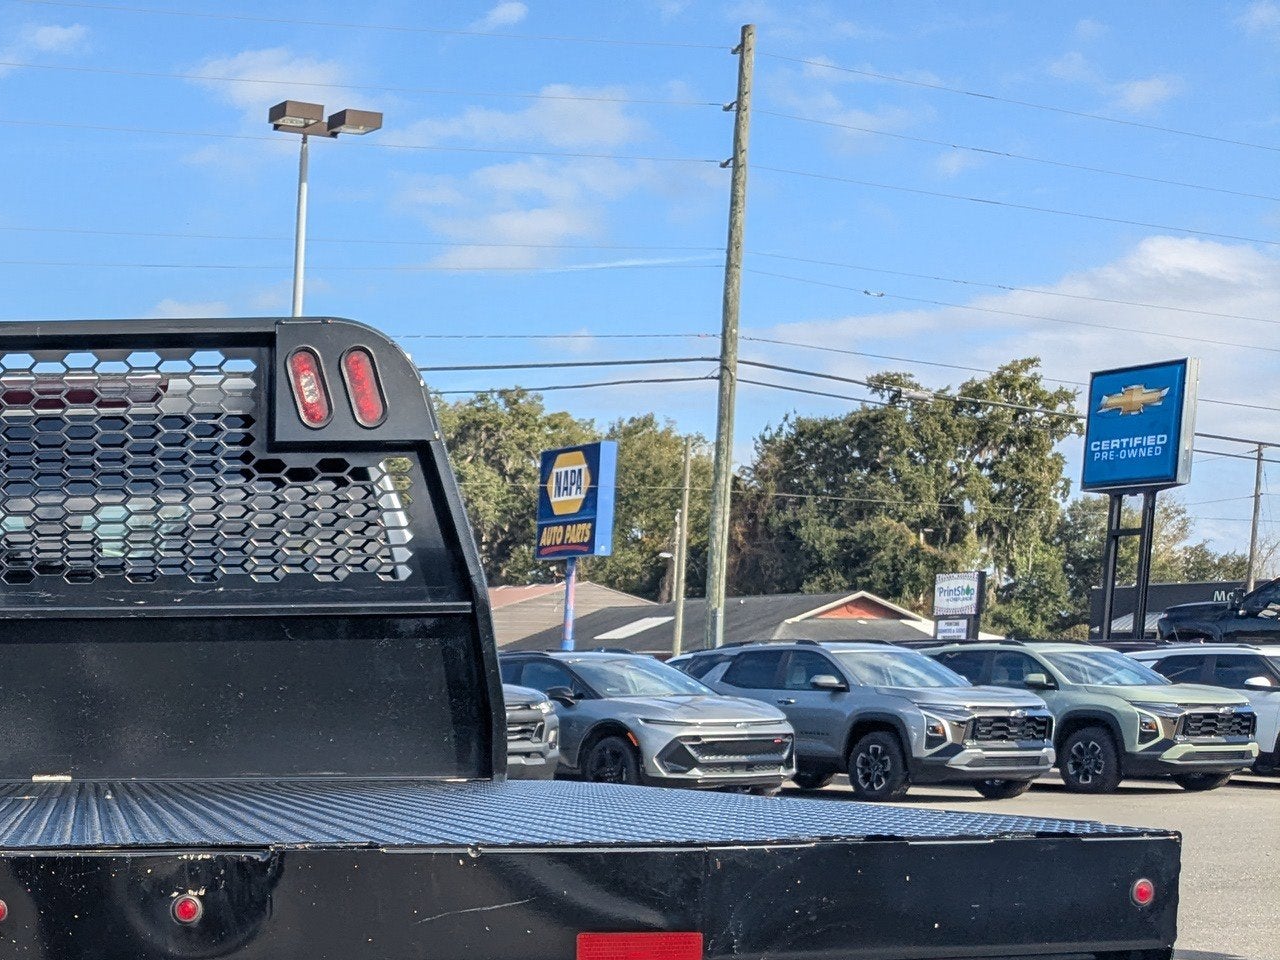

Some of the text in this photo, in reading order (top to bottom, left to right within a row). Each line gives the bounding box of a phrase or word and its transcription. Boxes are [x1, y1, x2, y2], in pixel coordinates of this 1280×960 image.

[1091, 434, 1168, 451] CERTIFIED
[1094, 447, 1162, 461] PRE-OWNED
[554, 468, 583, 498] NAPA
[540, 523, 593, 546] AUTO PARTS
